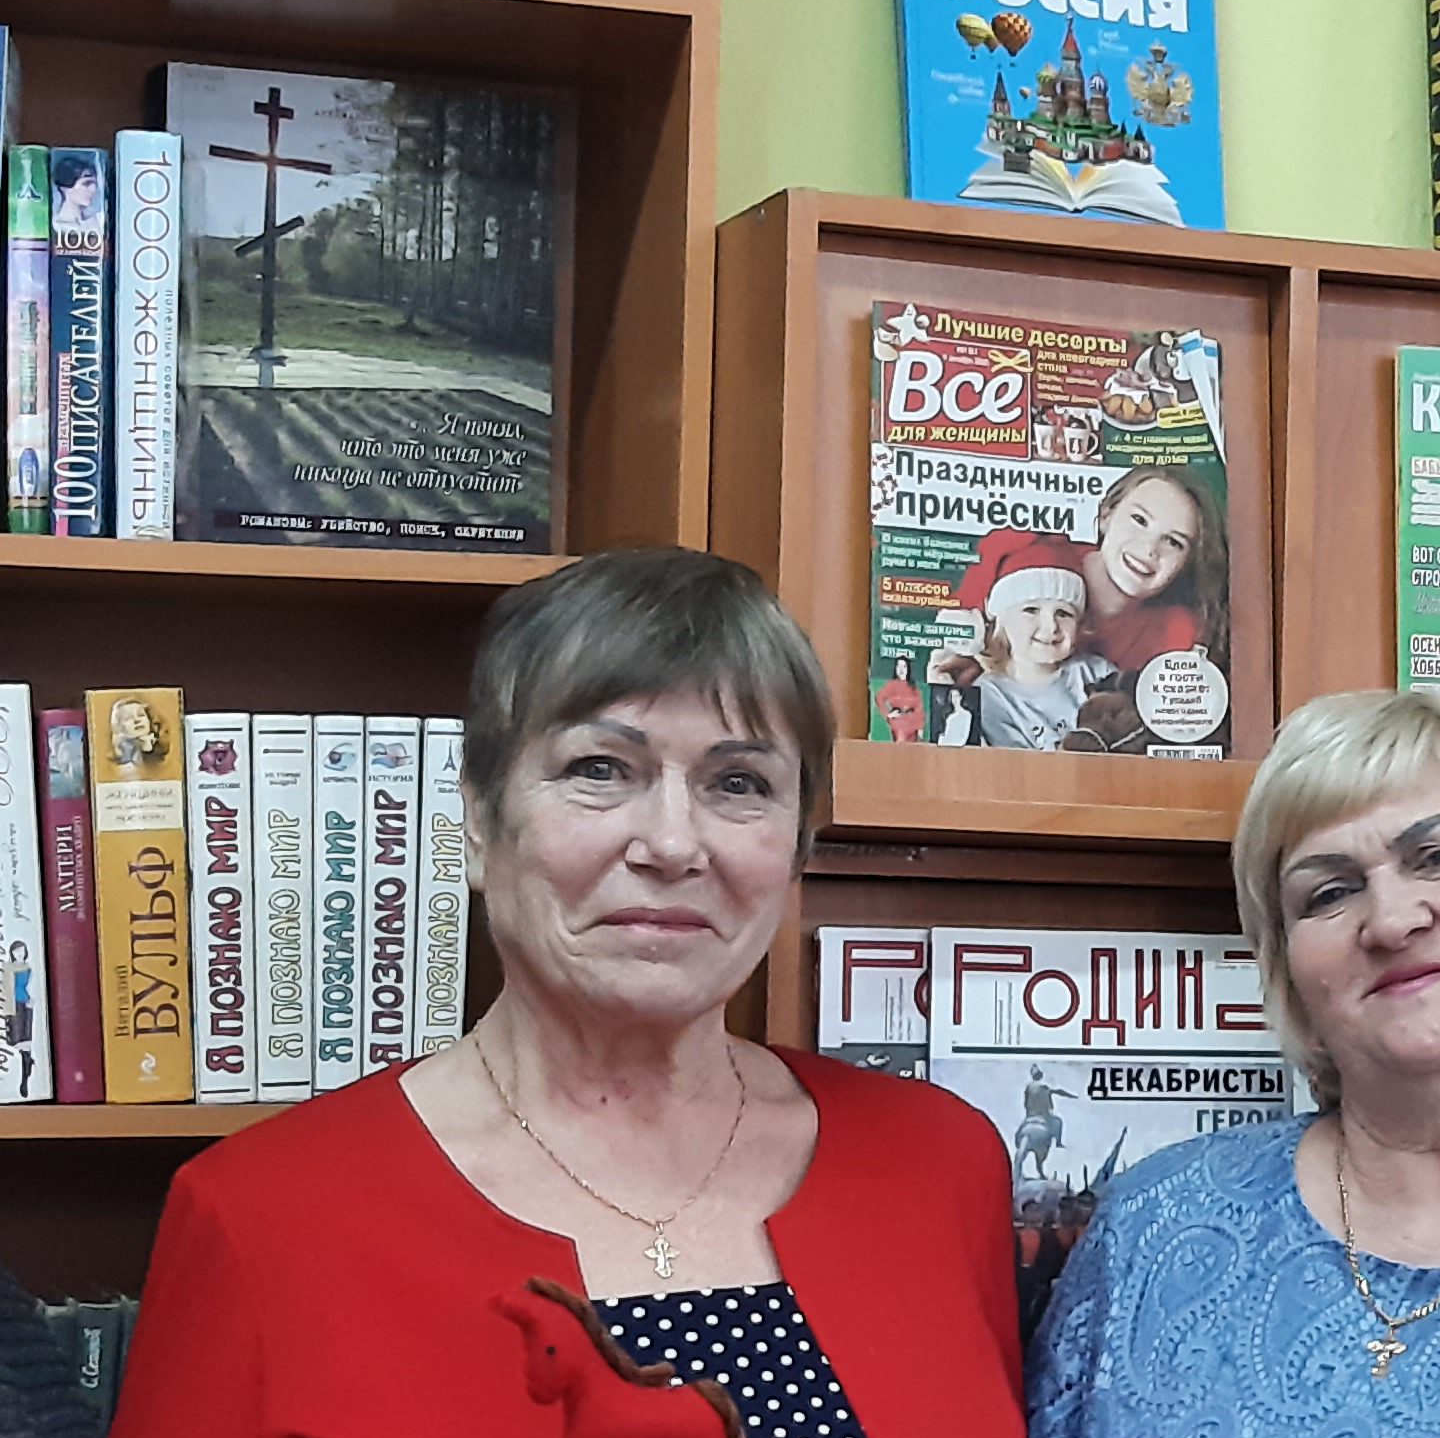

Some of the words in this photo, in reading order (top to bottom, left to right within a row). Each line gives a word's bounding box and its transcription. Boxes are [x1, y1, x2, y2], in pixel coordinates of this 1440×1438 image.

[56, 230, 101, 249] 100
[133, 151, 174, 282] 1000
[66, 256, 101, 457] ПИСАТЕЛЕЙ
[934, 312, 1024, 340] Лучшие
[1028, 328, 1128, 354] десерты
[888, 351, 1023, 424] Все
[341, 436, 381, 457] что
[390, 438, 425, 460] это
[434, 444, 479, 463] меня
[485, 449, 527, 469] уже
[439, 413, 457, 435] Я
[888, 426, 925, 442] для
[930, 427, 1027, 446] женщины
[53, 455, 97, 522] 100
[293, 464, 371, 490] никогда
[378, 469, 399, 487] не
[894, 450, 1103, 497] Праздничные
[1412, 545, 1434, 563] ВОТ
[204, 795, 240, 875] МИР
[268, 808, 301, 880] МИР
[324, 810, 356, 883] МИР
[373, 788, 408, 866] МИР
[431, 812, 463, 883] МИР
[56, 825, 76, 913] МАТЕРИ
[129, 846, 180, 1039] ВУЛЬФ
[207, 886, 245, 1036] ПОЗНАЮ
[268, 888, 303, 1025] ПОЗНАЮ
[321, 890, 355, 1029] ПОЗНАЮ
[371, 876, 407, 1034] ПОЗНАЮ
[426, 891, 460, 1027] ПОЗНАЮ
[206, 1044, 245, 1074] Я
[268, 1032, 304, 1059] Я
[319, 1035, 354, 1062] Я
[370, 1042, 403, 1064] Я
[1088, 1068, 1284, 1097] ДЕКАБРИСТЫ
